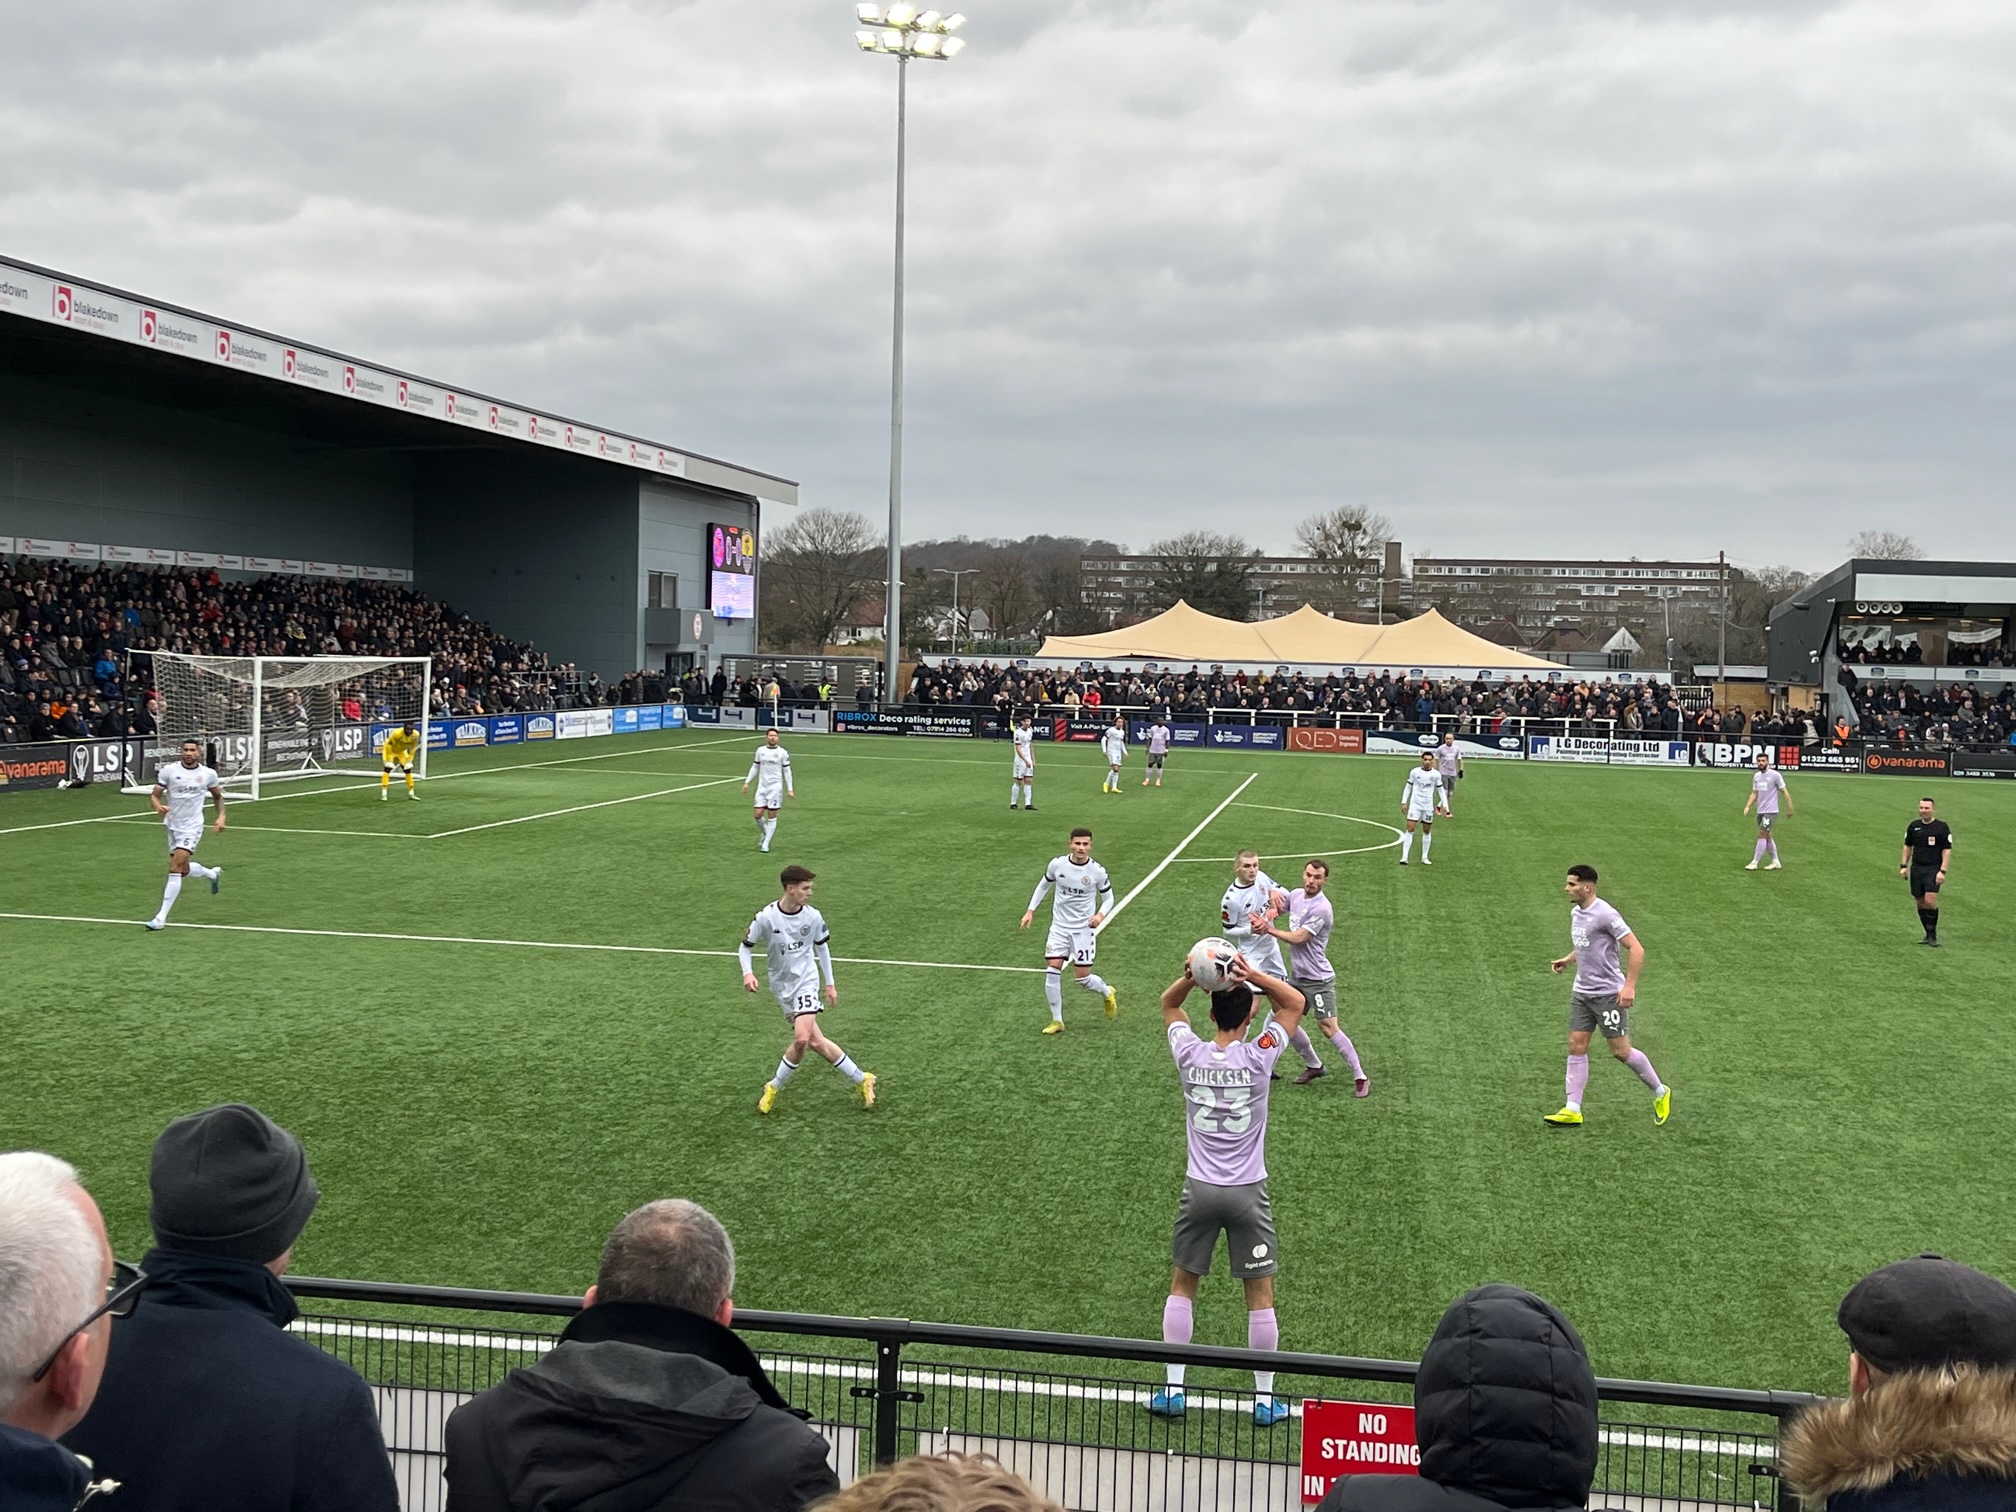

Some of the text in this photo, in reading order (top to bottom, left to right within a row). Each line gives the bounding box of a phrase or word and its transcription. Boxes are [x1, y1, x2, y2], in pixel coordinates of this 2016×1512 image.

[74, 300, 119, 323] blakedown
[158, 323, 198, 344] blakedown
[837, 712, 877, 721] RIBROX
[879, 714, 903, 723] Deco
[904, 715, 932, 725] rating
[933, 717, 972, 726] services
[335, 728, 362, 752] LSP
[1295, 731, 1336, 749] QED
[1643, 742, 1659, 752] Ltd
[1714, 743, 1776, 765] BPM
[1801, 755, 1827, 763] 01322
[1882, 757, 1946, 769] vanarama
[7, 760, 67, 779] vanarama
[787, 941, 804, 951] LSP
[1077, 950, 1089, 961] 21
[797, 994, 812, 1010] 35
[1314, 993, 1325, 1008] 8
[1602, 1010, 1620, 1025] 20
[1188, 1066, 1252, 1085] CHICKSEN
[1191, 1086, 1252, 1134] 23
[1358, 1413, 1387, 1435] NO
[1321, 1437, 1421, 1466] STANDING
[1304, 1475, 1324, 1496] IN
